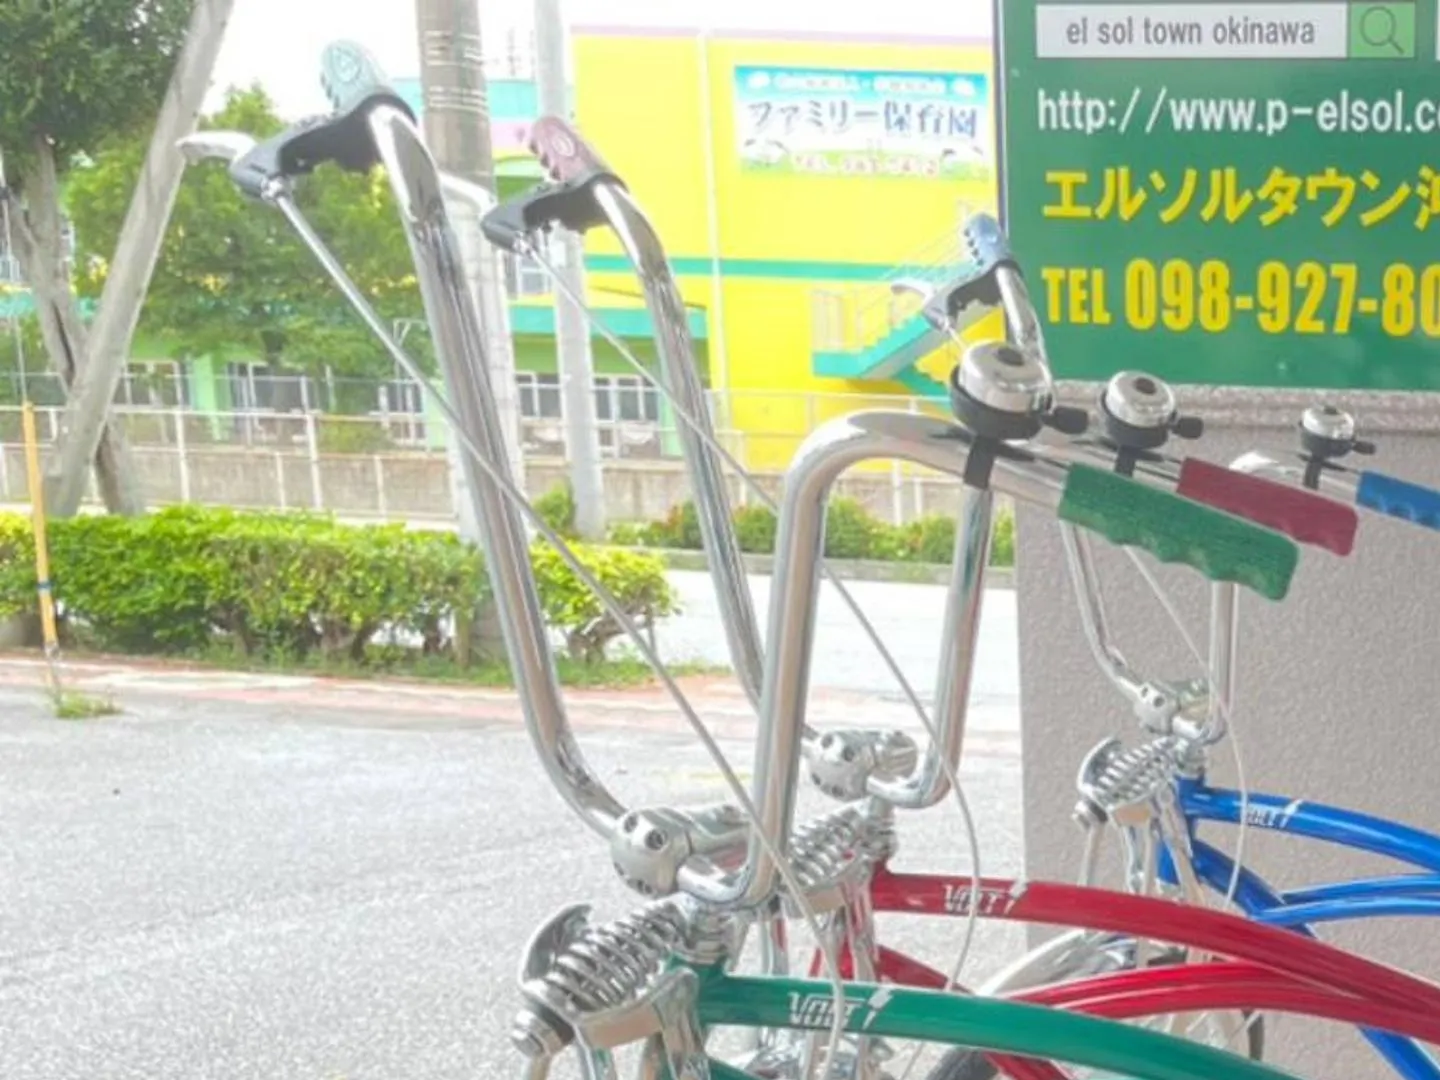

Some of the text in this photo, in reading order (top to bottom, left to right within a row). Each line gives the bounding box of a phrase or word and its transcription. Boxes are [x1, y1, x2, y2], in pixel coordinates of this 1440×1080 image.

[1066, 15, 1315, 46] el sol town okinawa
[1041, 267, 1110, 325] TEL
